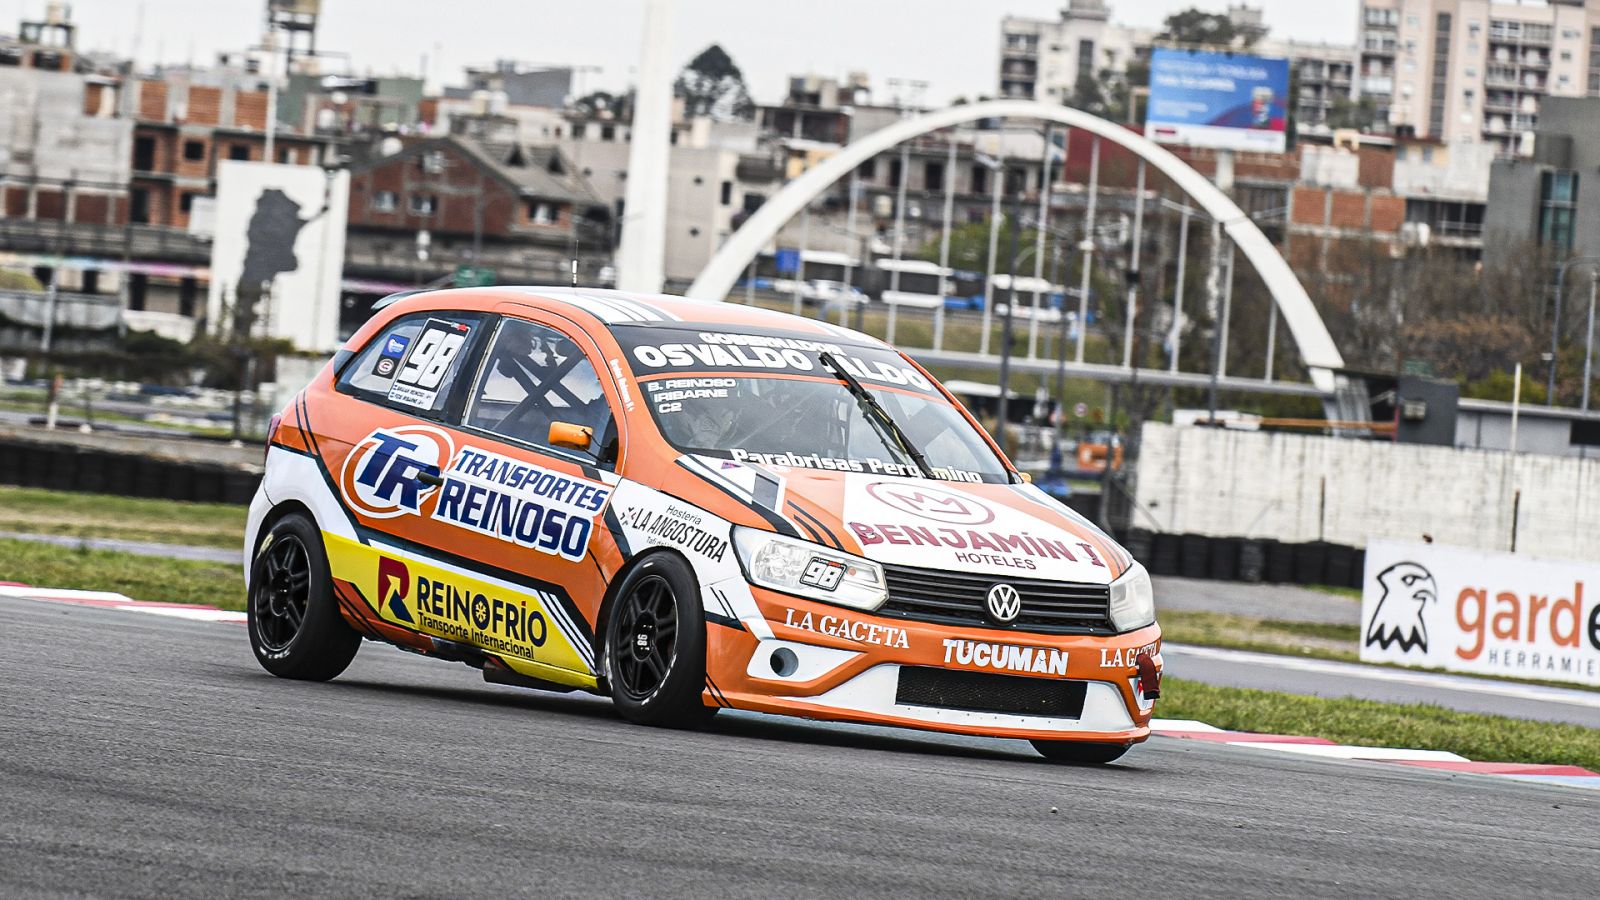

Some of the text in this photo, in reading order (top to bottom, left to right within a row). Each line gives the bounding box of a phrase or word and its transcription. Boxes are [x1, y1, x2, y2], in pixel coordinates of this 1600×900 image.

[398, 328, 465, 388] 98
[633, 343, 813, 371] OSVALDO
[699, 331, 847, 357] GOBERNADOR
[647, 377, 737, 392] B. REINOSO
[654, 388, 728, 403] IRIBARNE
[658, 402, 682, 414] C2
[356, 432, 440, 510] TR
[454, 449, 609, 512] TRANSPORTES
[730, 448, 983, 483] Parabrisas Pergmino
[436, 478, 591, 557] REINOSO
[632, 507, 728, 563] LA ANGOSTURA
[848, 521, 1078, 563] BENJAMÍN
[801, 560, 843, 589] 98
[955, 551, 1037, 570] HOTELES
[418, 611, 534, 659] Transporte Internacional
[784, 608, 910, 649] LA GACETA
[942, 639, 1068, 676] TUCUMAN
[1099, 648, 1125, 668] LA
[1489, 648, 1600, 677] HERRAMIE
